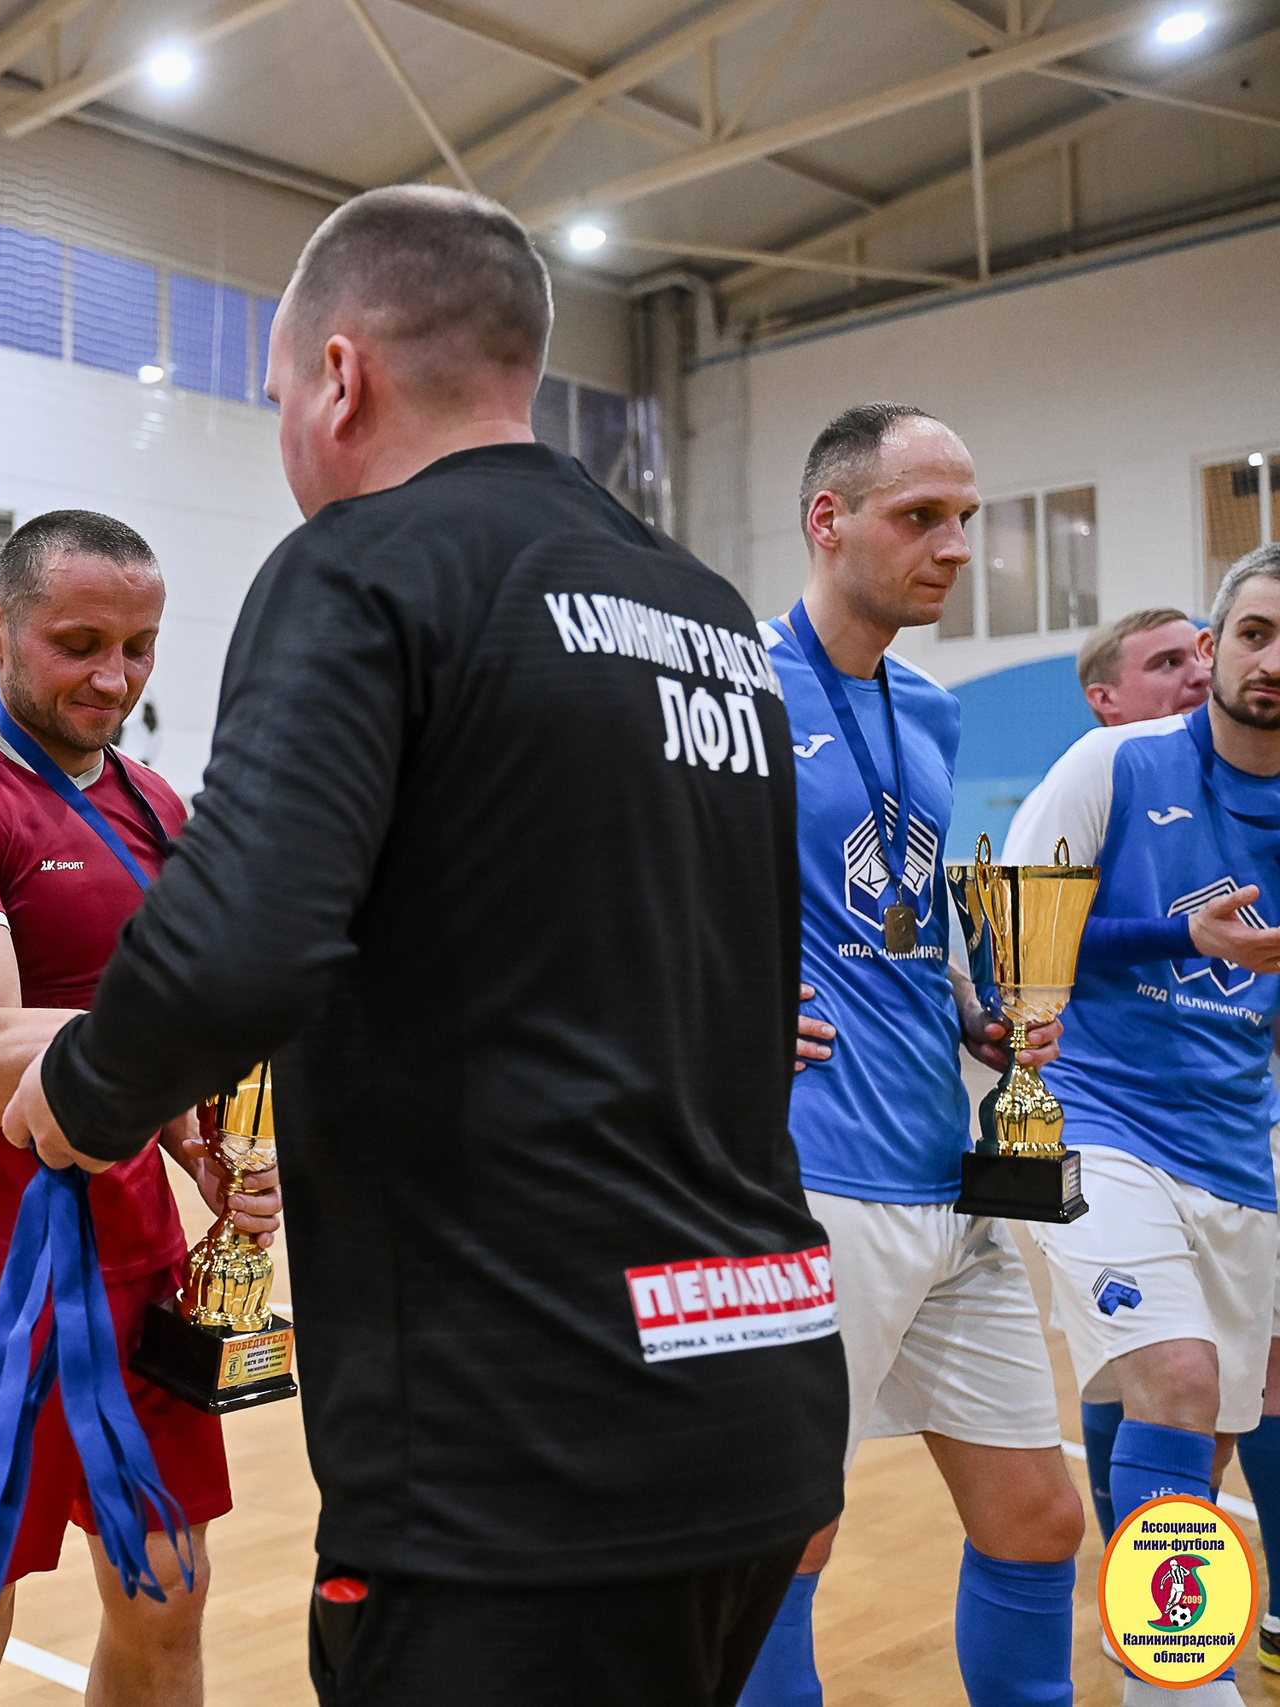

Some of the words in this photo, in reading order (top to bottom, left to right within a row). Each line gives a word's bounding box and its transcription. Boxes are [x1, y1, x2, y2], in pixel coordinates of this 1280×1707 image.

[656, 675, 770, 778] ЛФЛ
[56, 861, 85, 870] SPORT
[838, 943, 874, 959] КПД
[1136, 982, 1168, 1003] КПД
[228, 1332, 290, 1353] ПОБЕДИТЕЛЬ
